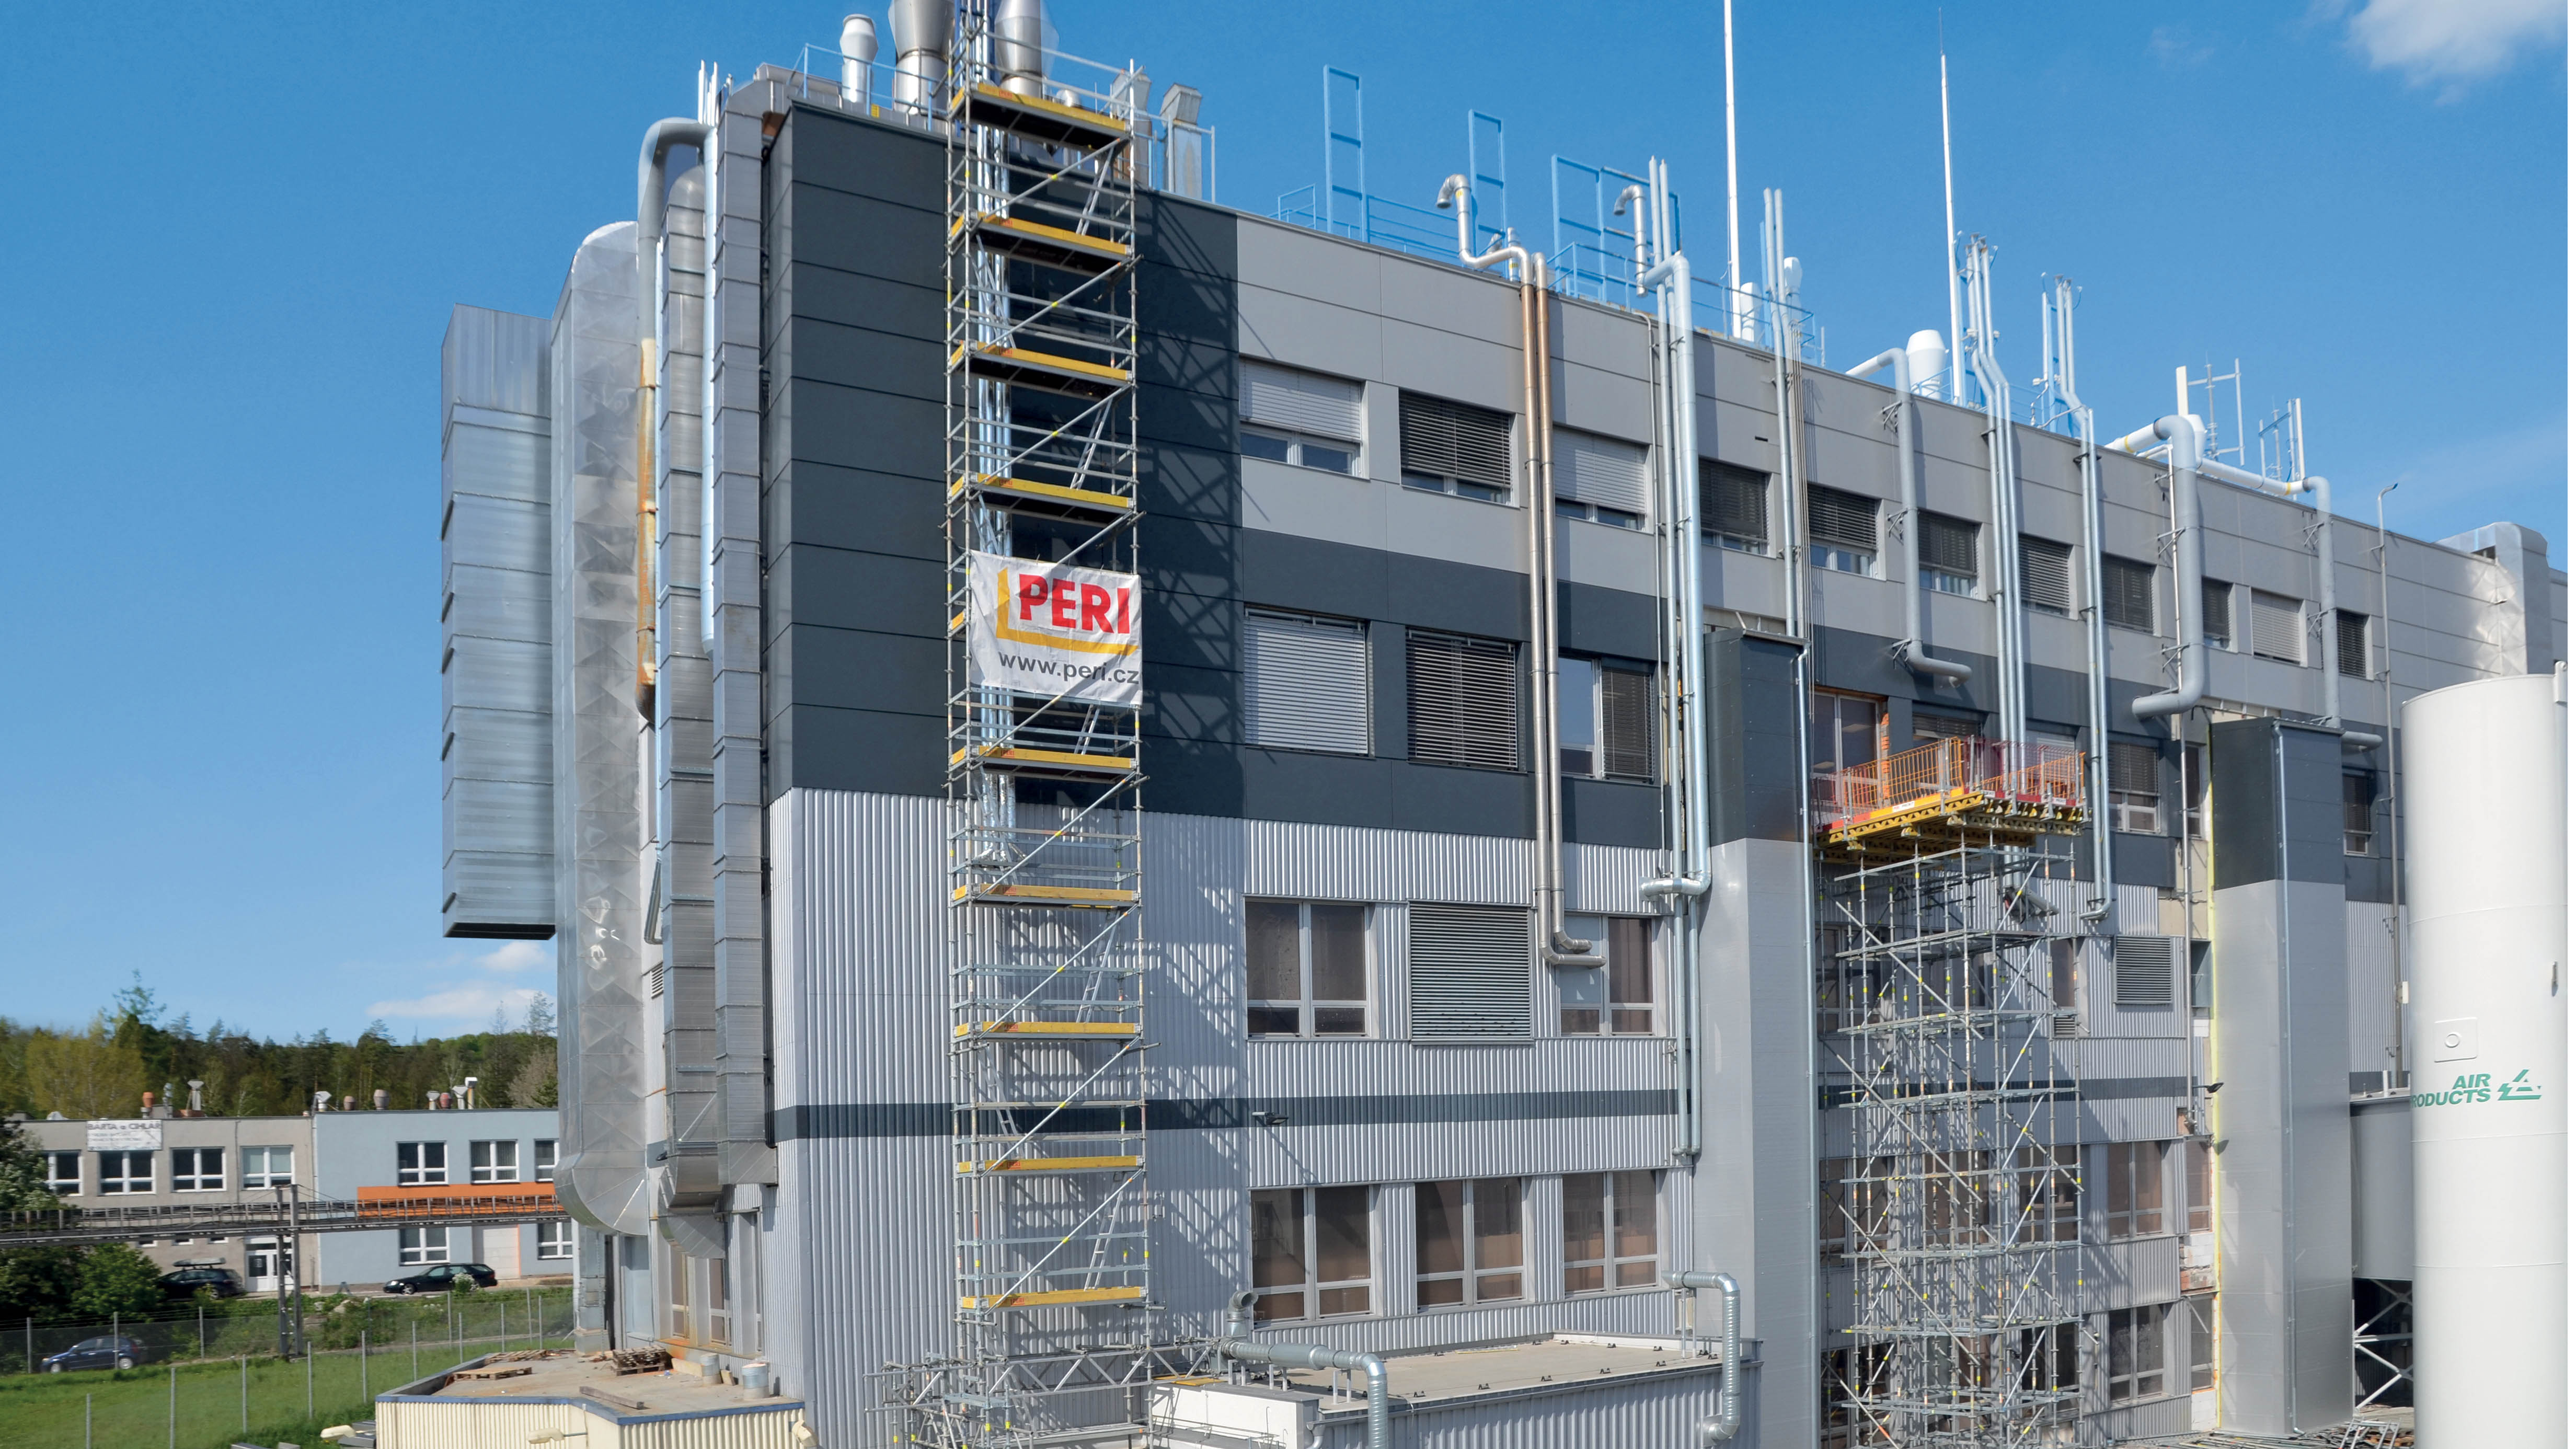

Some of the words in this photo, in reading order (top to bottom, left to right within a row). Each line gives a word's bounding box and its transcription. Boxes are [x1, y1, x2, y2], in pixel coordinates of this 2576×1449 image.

[1019, 573, 1130, 634] PERI
[998, 651, 1139, 685] www.peri.cz
[2452, 1073, 2491, 1089] AIR
[2410, 1088, 2491, 1108] RODUCTS
